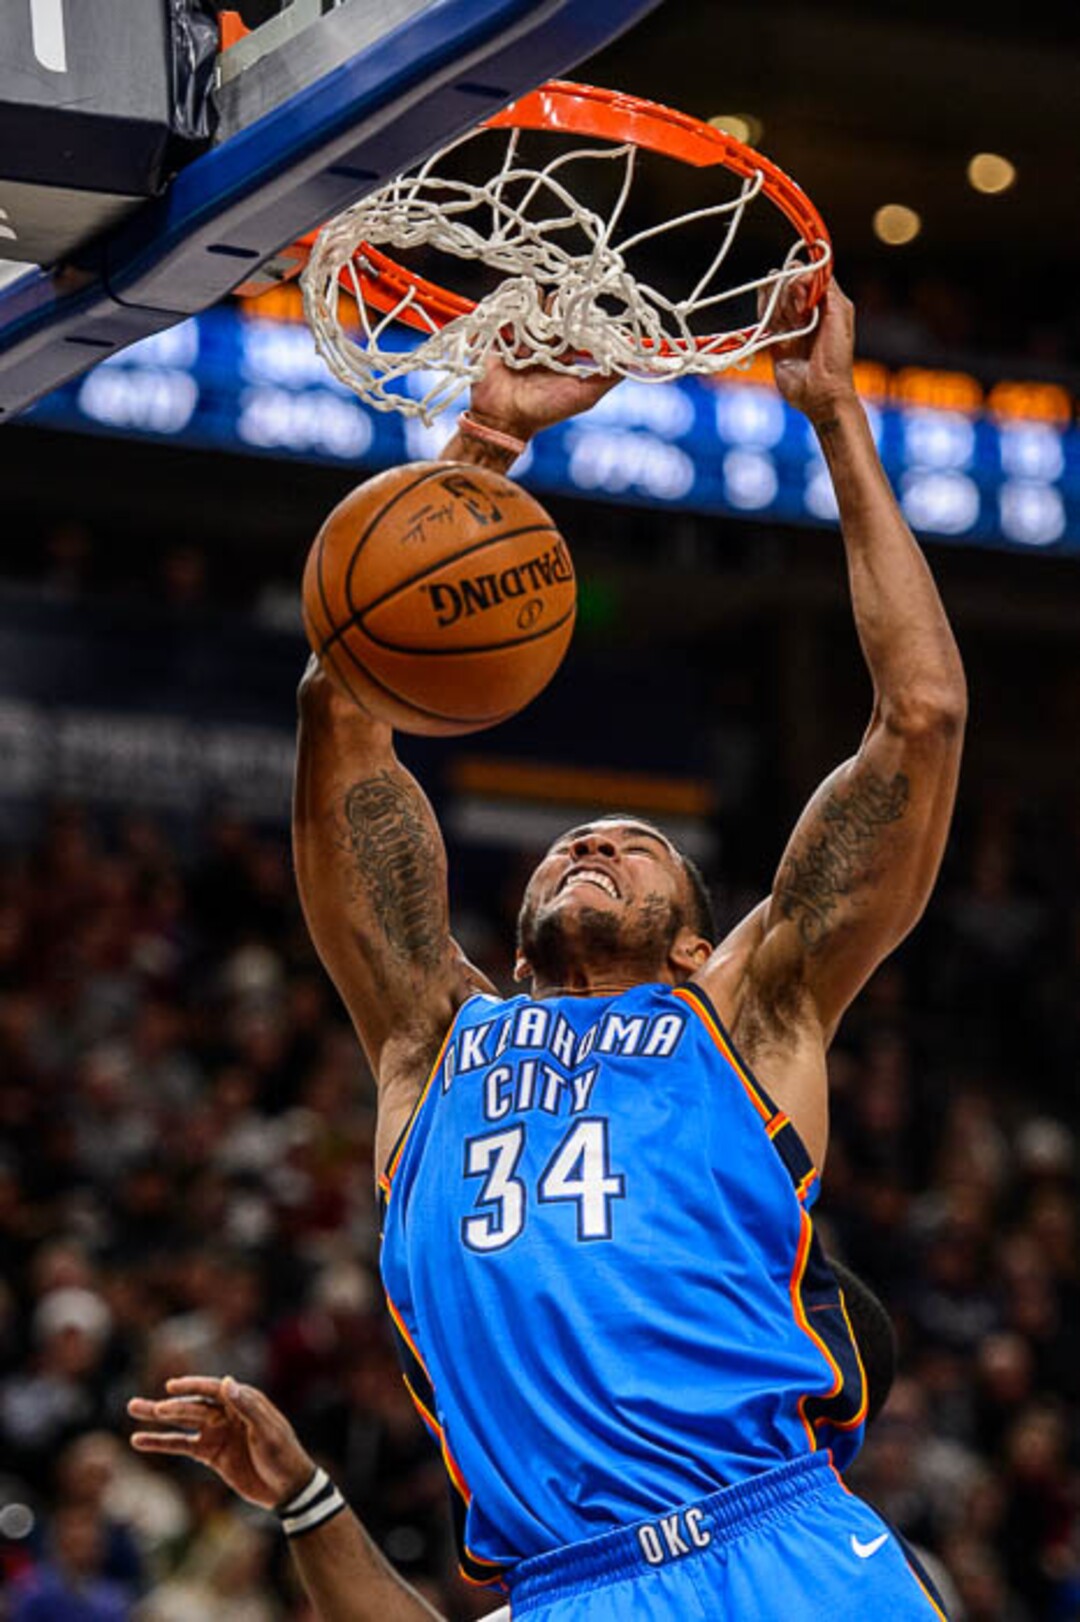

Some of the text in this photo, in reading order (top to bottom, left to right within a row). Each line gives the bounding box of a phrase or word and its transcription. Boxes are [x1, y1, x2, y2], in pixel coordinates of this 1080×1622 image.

[429, 541, 573, 628] PALDING
[484, 1057, 599, 1122] CITY
[461, 1116, 626, 1253] 34
[637, 1507, 712, 1565] OKC
